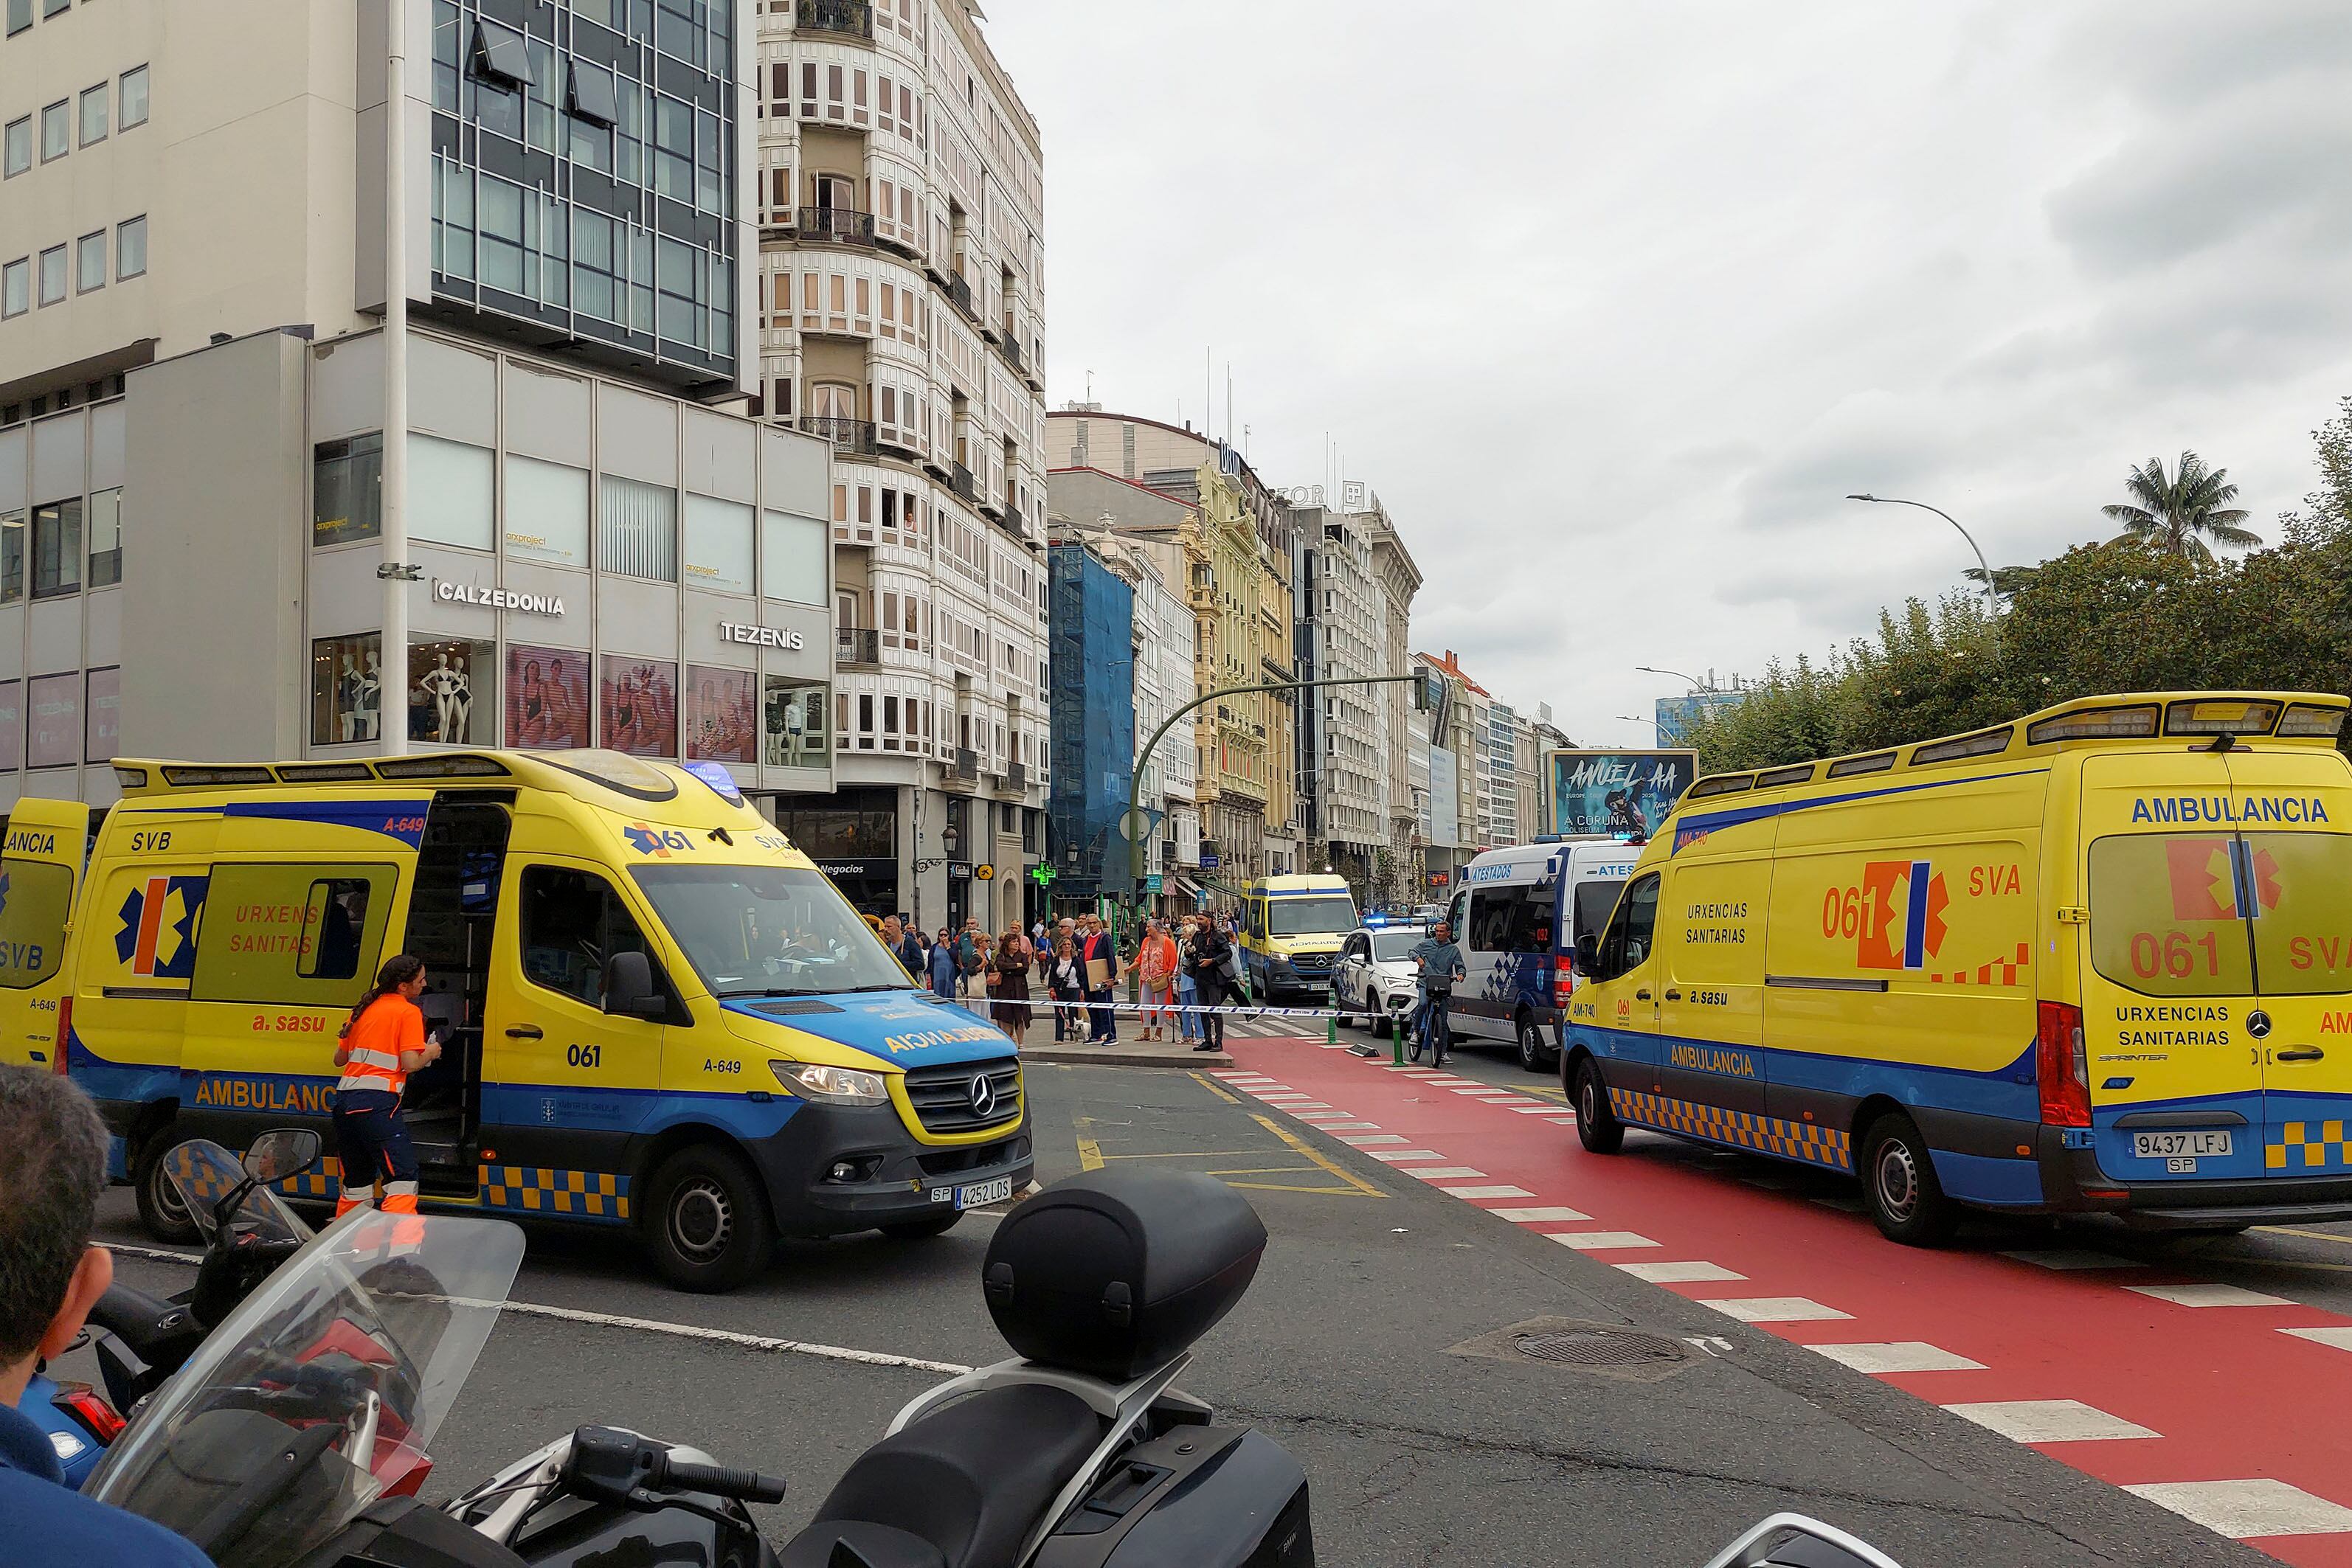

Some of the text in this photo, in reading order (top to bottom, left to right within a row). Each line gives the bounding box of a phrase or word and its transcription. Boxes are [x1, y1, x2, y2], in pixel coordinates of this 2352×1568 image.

[437, 581, 567, 615] CALZEDONIA
[1567, 757, 1678, 794] ANUEL AA
[1564, 811, 1629, 826] A CORUÑA
[2131, 797, 2330, 823] AMBULANCIA
[383, 817, 425, 833] A-649
[3, 831, 55, 854] ANCIA
[131, 831, 172, 851] SVB
[643, 829, 696, 850] 061
[754, 835, 792, 850] SVB
[820, 864, 864, 875] Negocios
[1472, 864, 1512, 881] ATESTADOS
[1968, 864, 2021, 898] SVA
[1687, 902, 1748, 920] URXENCIAS
[1822, 886, 1877, 940] 061
[1537, 928, 1548, 941] 092
[1686, 928, 1746, 945] SANITARIAS
[229, 934, 313, 954] SANITAS
[2130, 931, 2219, 979] 061
[30, 997, 56, 1011] A-649
[1573, 1003, 1596, 1019] AM-740
[1617, 999, 1629, 1016] 061
[2115, 1006, 2230, 1022] URXENCIAS
[252, 1014, 326, 1033] a. sasu
[2118, 1030, 2230, 1046] SANITARIAS
[567, 1043, 601, 1069] 061
[1670, 1044, 1755, 1078] AMBULANCIA
[2097, 1053, 2169, 1062] SPRINTER
[702, 1058, 741, 1074] A-649
[195, 1078, 337, 1113] AMBULANC
[2139, 1135, 2187, 1155] 9437
[2193, 1134, 2229, 1154] LFJ
[2169, 1159, 2194, 1172] SP
[933, 1188, 950, 1201] SP
[963, 1180, 1009, 1205] 4252 LDS
[1283, 1532, 1297, 1554] BMW
